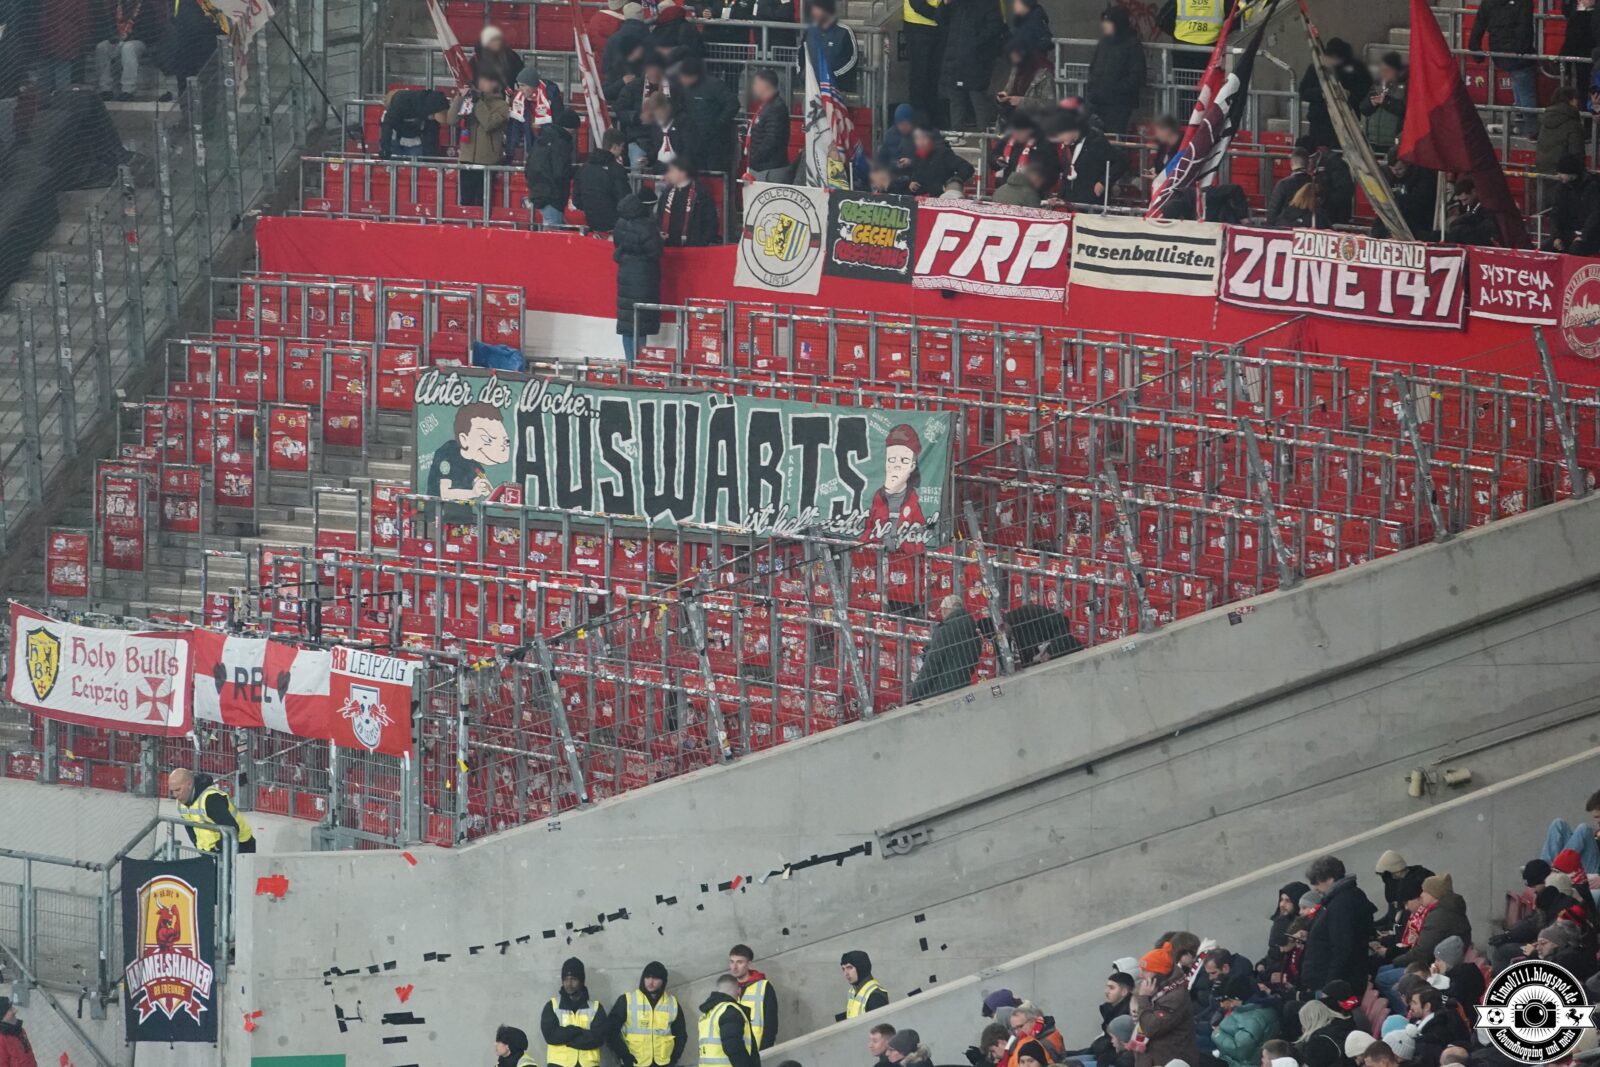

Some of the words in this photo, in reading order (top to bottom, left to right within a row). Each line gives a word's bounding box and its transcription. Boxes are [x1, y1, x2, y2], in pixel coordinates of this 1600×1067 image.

[1189, 21, 1208, 31] 1788
[757, 187, 811, 211] COLECTIVO
[852, 223, 896, 247] GEGEN
[914, 212, 1069, 285] FRP
[1293, 231, 1339, 259] ZONE
[1360, 239, 1426, 269] JUGEND
[1077, 243, 1215, 268] rasenballisten
[1229, 235, 1366, 310] ZONE
[1379, 256, 1461, 317] 147
[1480, 264, 1554, 290] SYSTEMA
[415, 370, 473, 406] Unter
[479, 374, 512, 409] der
[511, 394, 872, 526] AUSWÄRTS
[72, 636, 116, 676] Holy
[126, 646, 179, 676] Bulls
[332, 647, 348, 672] RB
[349, 651, 409, 682] LEIPZIG
[72, 675, 129, 711] Leipzig
[234, 666, 273, 704] RBL
[162, 985, 186, 996] FREUNDE
